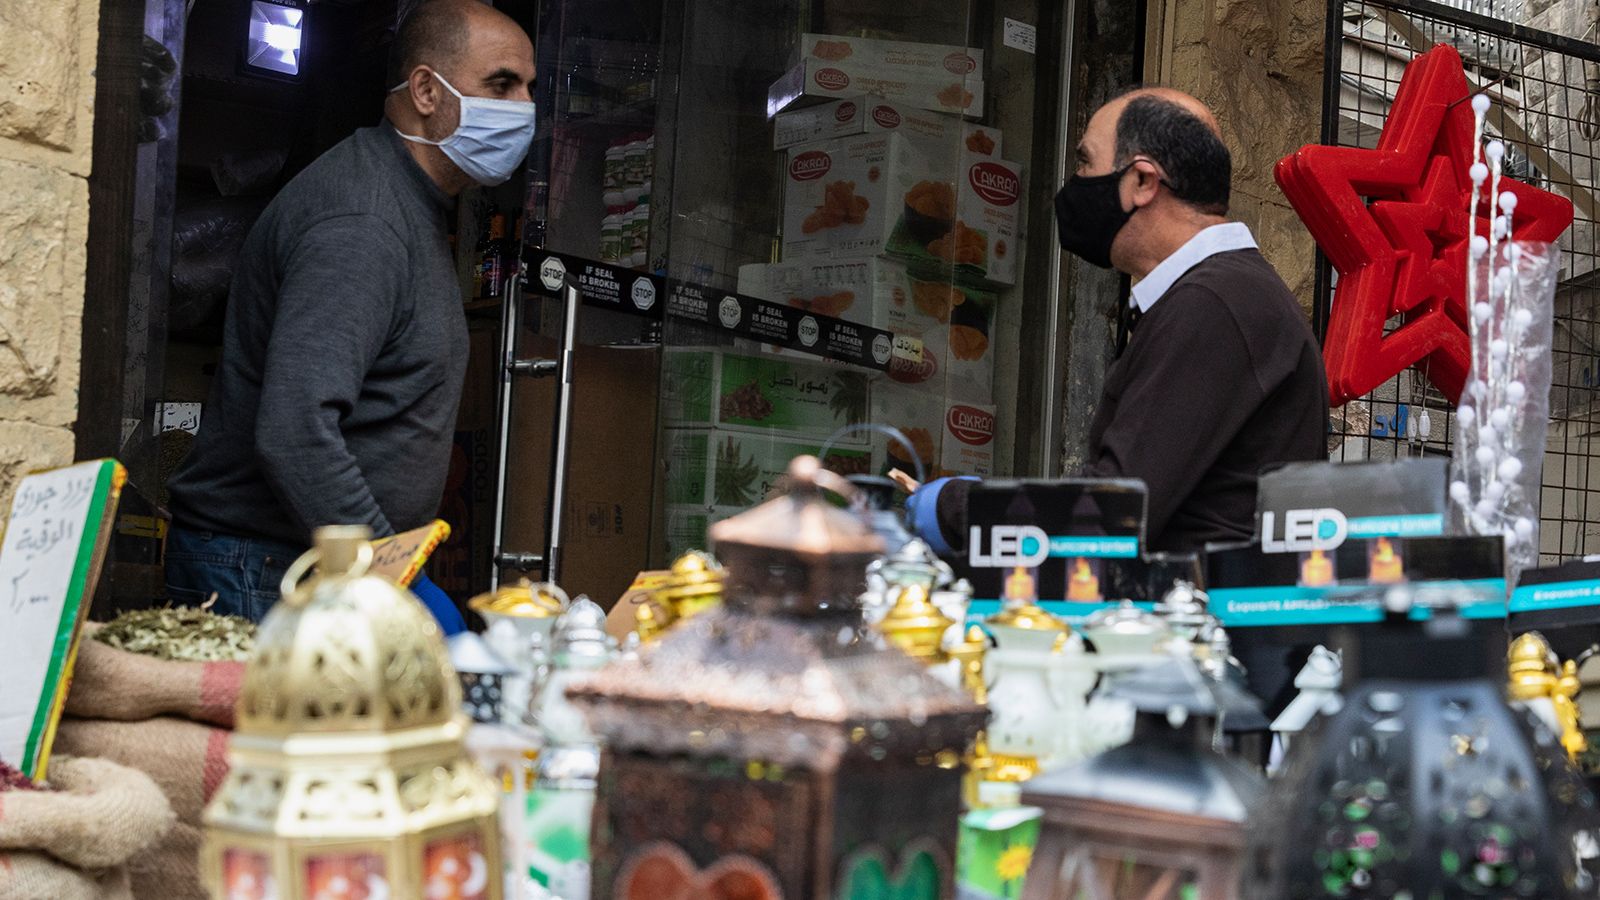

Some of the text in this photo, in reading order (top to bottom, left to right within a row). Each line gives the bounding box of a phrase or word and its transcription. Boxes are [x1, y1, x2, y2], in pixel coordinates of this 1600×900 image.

[792, 156, 830, 175] CAKRAN
[972, 166, 1018, 198] CAKRAN
[544, 268, 562, 280] STOP
[585, 266, 615, 279] IF SEAL
[578, 274, 621, 291] IS BROKEN
[635, 288, 653, 298] STOP
[676, 286, 703, 299] IF SEAL
[678, 296, 708, 310] BROKEN
[721, 306, 738, 318] STOP
[758, 305, 783, 318] IF SEAL
[752, 313, 788, 329] IS BROKEN
[801, 326, 816, 336] STOP
[835, 324, 858, 336] IF SEAL
[829, 332, 863, 346] IS BROKEN
[875, 345, 889, 354] STOP
[950, 407, 994, 436] CAKRAN
[474, 430, 488, 503] FOODS
[1262, 508, 1348, 553] LED
[969, 525, 1050, 567] LED
